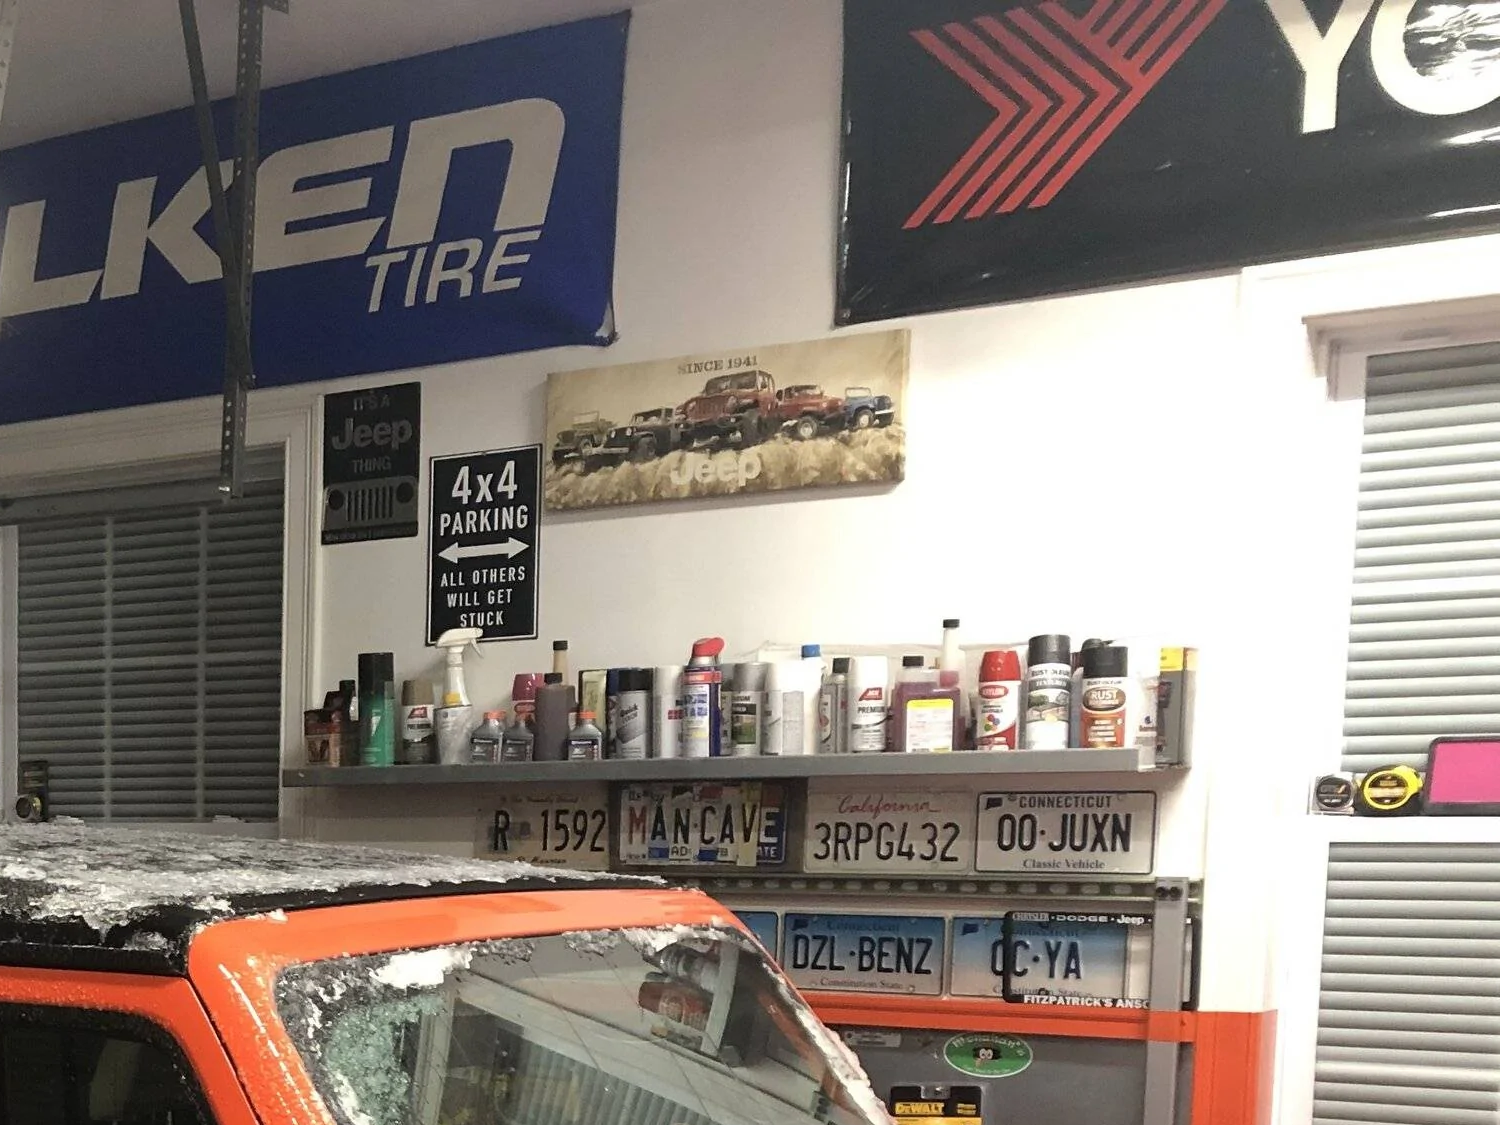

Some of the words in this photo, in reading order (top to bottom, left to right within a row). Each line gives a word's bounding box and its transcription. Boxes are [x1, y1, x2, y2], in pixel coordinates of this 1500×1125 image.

[364, 229, 541, 313] TIRE
[678, 359, 724, 375] SINCE
[727, 355, 758, 369] 1941
[331, 417, 413, 450] Jeep
[352, 456, 392, 474] THING
[670, 451, 761, 487] Jeep
[451, 460, 518, 505] 4x4
[439, 505, 529, 537] PARKING
[440, 572, 465, 587] ALL
[472, 566, 526, 585] OTHERS
[447, 591, 480, 608] WILL
[487, 588, 513, 605] GET
[460, 610, 504, 628] STUCK
[1091, 690, 1118, 700] RUST
[838, 794, 941, 819] California
[1019, 795, 1112, 809] CONNECTICUT
[494, 809, 510, 851] R
[541, 809, 606, 852] 1592
[813, 821, 961, 862] 3RPG432
[1023, 858, 1061, 869] Classic
[1065, 858, 1105, 869] Vehicle
[1056, 914, 1109, 923] DODGE
[1116, 914, 1144, 925] Jeep
[1023, 995, 1112, 1008] FITZPATRICK'S
